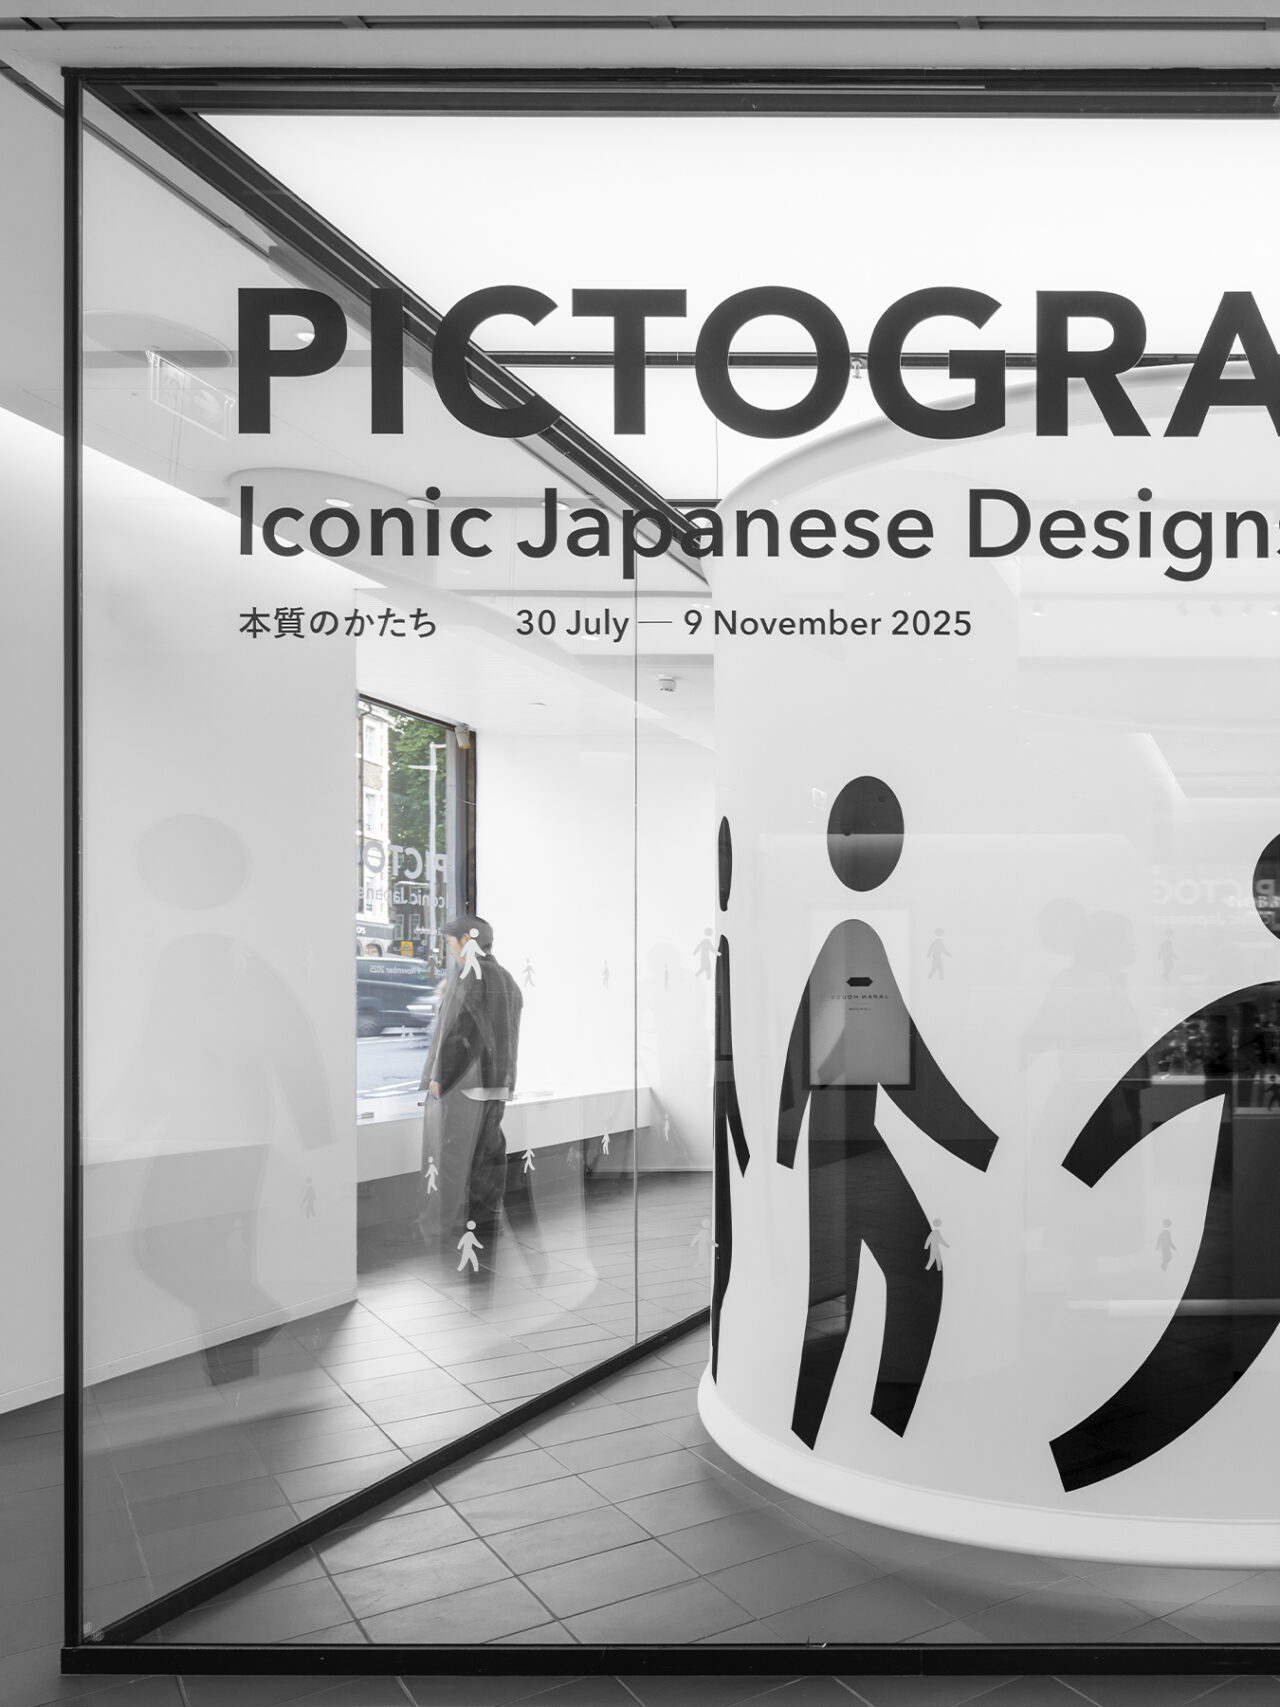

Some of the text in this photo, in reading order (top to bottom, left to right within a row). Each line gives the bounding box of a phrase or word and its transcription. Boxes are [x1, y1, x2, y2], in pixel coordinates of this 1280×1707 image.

[240, 486, 493, 558] Iconic
[517, 486, 935, 580] Japanese
[238, 606, 438, 640] 本質のかたち
[515, 610, 556, 636] 30
[565, 608, 630, 643] July
[684, 610, 702, 636] 9
[713, 608, 882, 636] November
[891, 610, 973, 636] 2025
